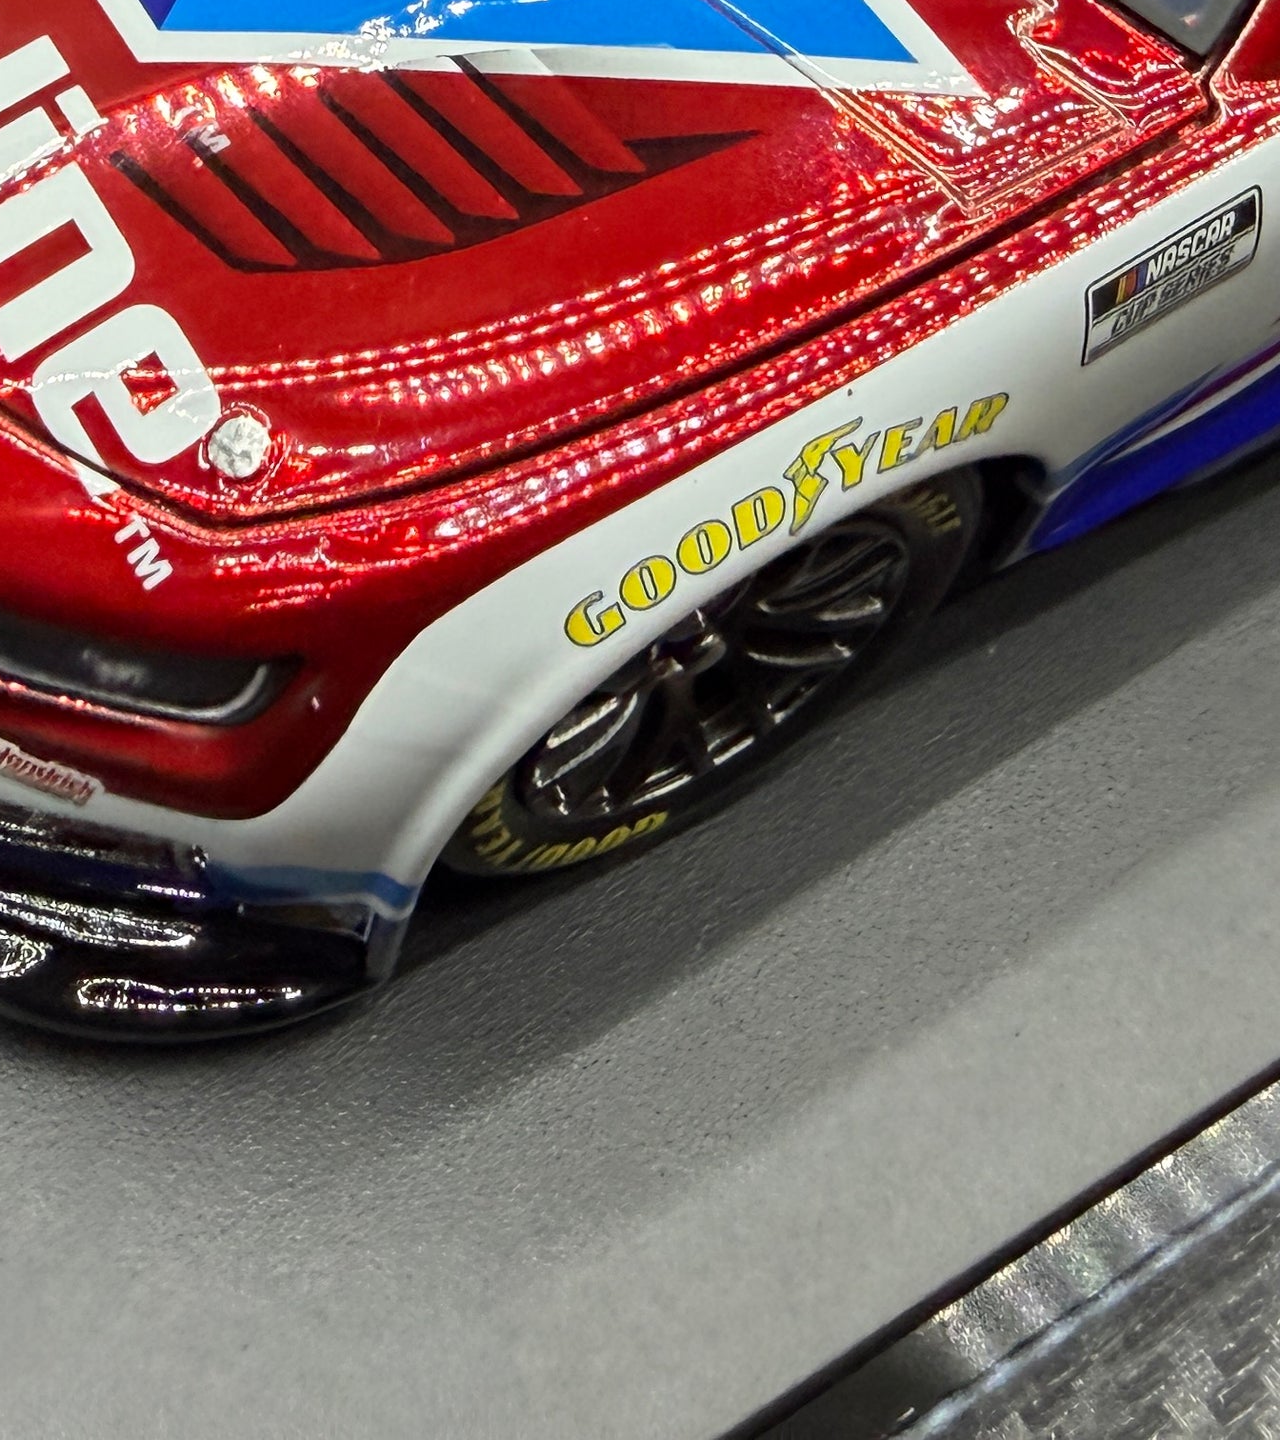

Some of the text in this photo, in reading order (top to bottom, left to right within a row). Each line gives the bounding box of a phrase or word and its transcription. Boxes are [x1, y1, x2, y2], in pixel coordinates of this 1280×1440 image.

[1145, 210, 1236, 286] NASCAR
[113, 514, 171, 592] TM
[563, 392, 1010, 648] GOODYEAR
